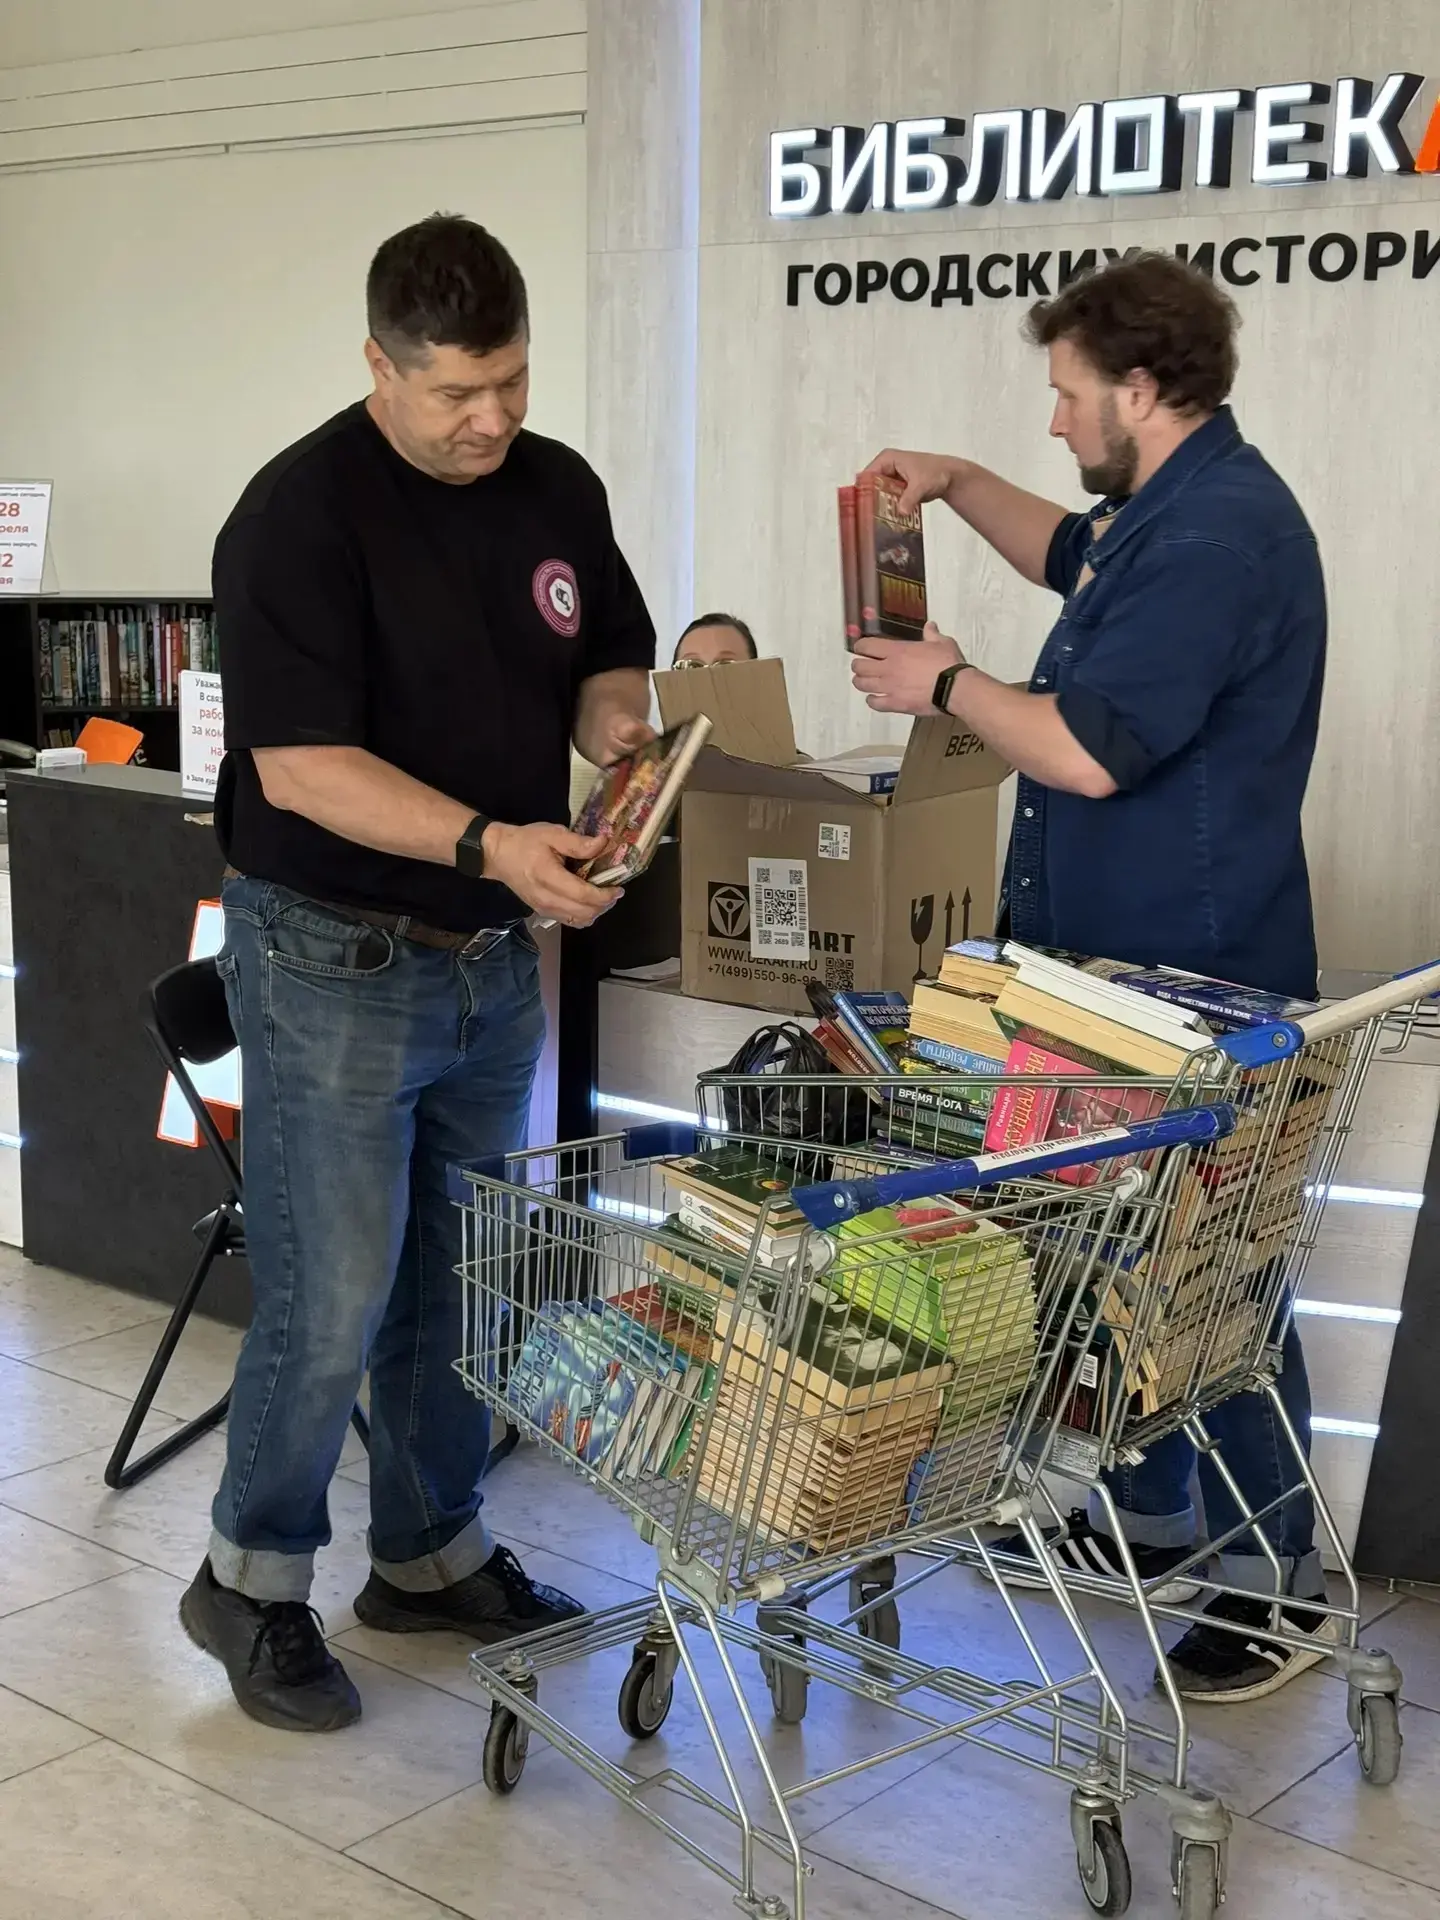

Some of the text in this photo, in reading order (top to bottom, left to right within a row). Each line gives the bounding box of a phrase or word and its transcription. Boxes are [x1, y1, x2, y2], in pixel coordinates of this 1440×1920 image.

[0, 553, 13, 568] 2
[210, 746, 226, 758] на
[898, 1088, 933, 1104] ВРЕМЯ
[1002, 1050, 1047, 1150] КУНДАЛНИ
